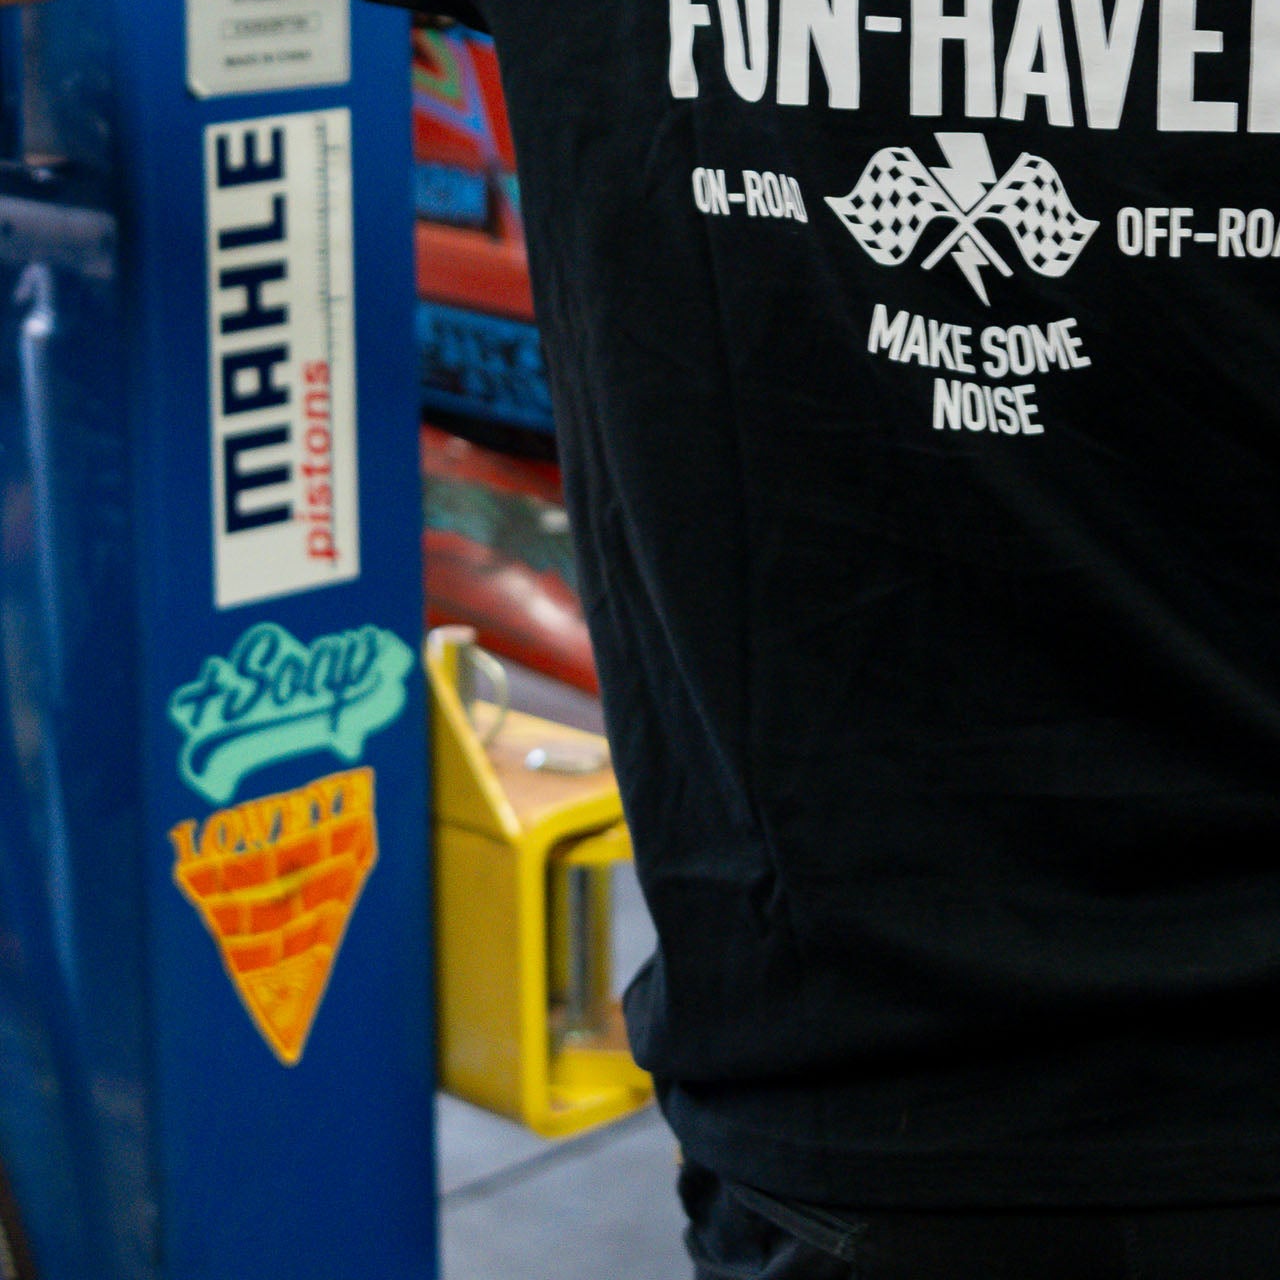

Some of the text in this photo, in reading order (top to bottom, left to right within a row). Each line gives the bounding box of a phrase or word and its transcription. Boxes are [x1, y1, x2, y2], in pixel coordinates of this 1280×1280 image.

[691, 166, 809, 223] ON-ROAD
[215, 124, 295, 535] MAHLE
[867, 303, 1092, 379] MAKE SOME
[932, 377, 1045, 436] NOISE
[294, 358, 340, 563] pistons
